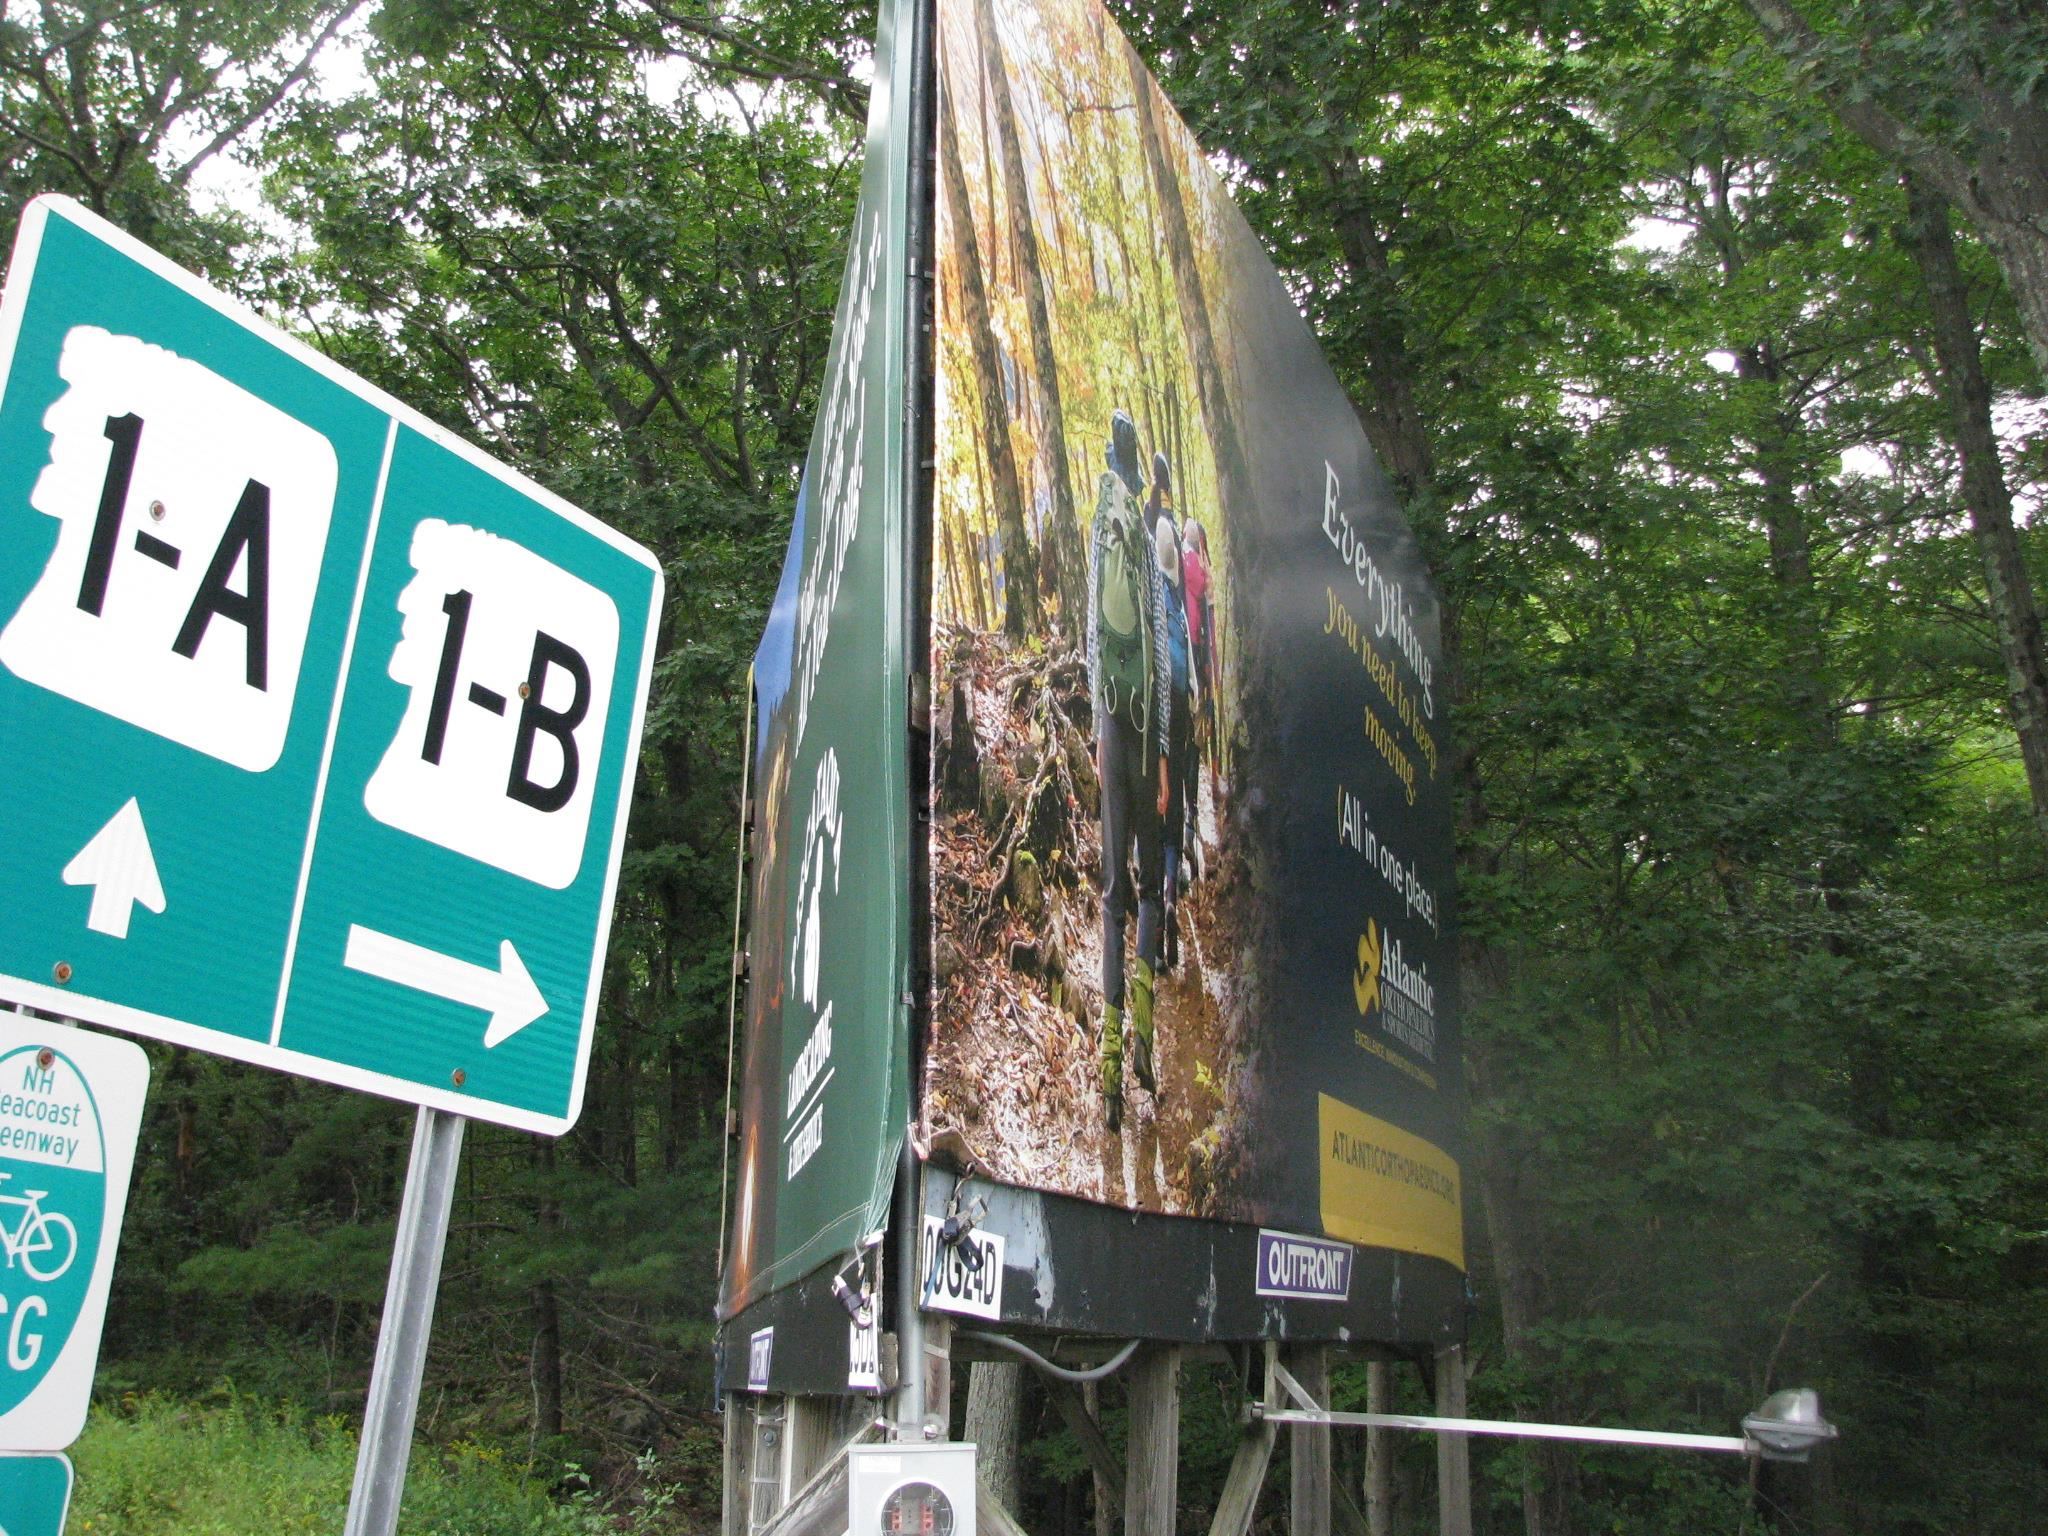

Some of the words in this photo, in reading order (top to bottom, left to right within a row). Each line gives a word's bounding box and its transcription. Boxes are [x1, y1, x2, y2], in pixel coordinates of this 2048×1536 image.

[831, 376, 865, 613] Long!
[76, 412, 271, 692] 1-A
[1322, 459, 1433, 720] Everything
[421, 588, 592, 813] 1-B
[1323, 586, 1358, 654] you
[1361, 635, 1395, 707] need
[1398, 681, 1410, 730] to
[1412, 694, 1436, 781] keep
[1364, 811, 1377, 868] in
[1380, 845, 1403, 894] one
[1381, 927, 1434, 1017] Atlantic
[0, 1092, 81, 1127] eacoast
[22, 1065, 56, 1095] NH
[787, 1000, 832, 1120] LANDSCAPING
[1268, 1240, 1344, 1291] OUTFRONT
[0, 1293, 48, 1371] G
